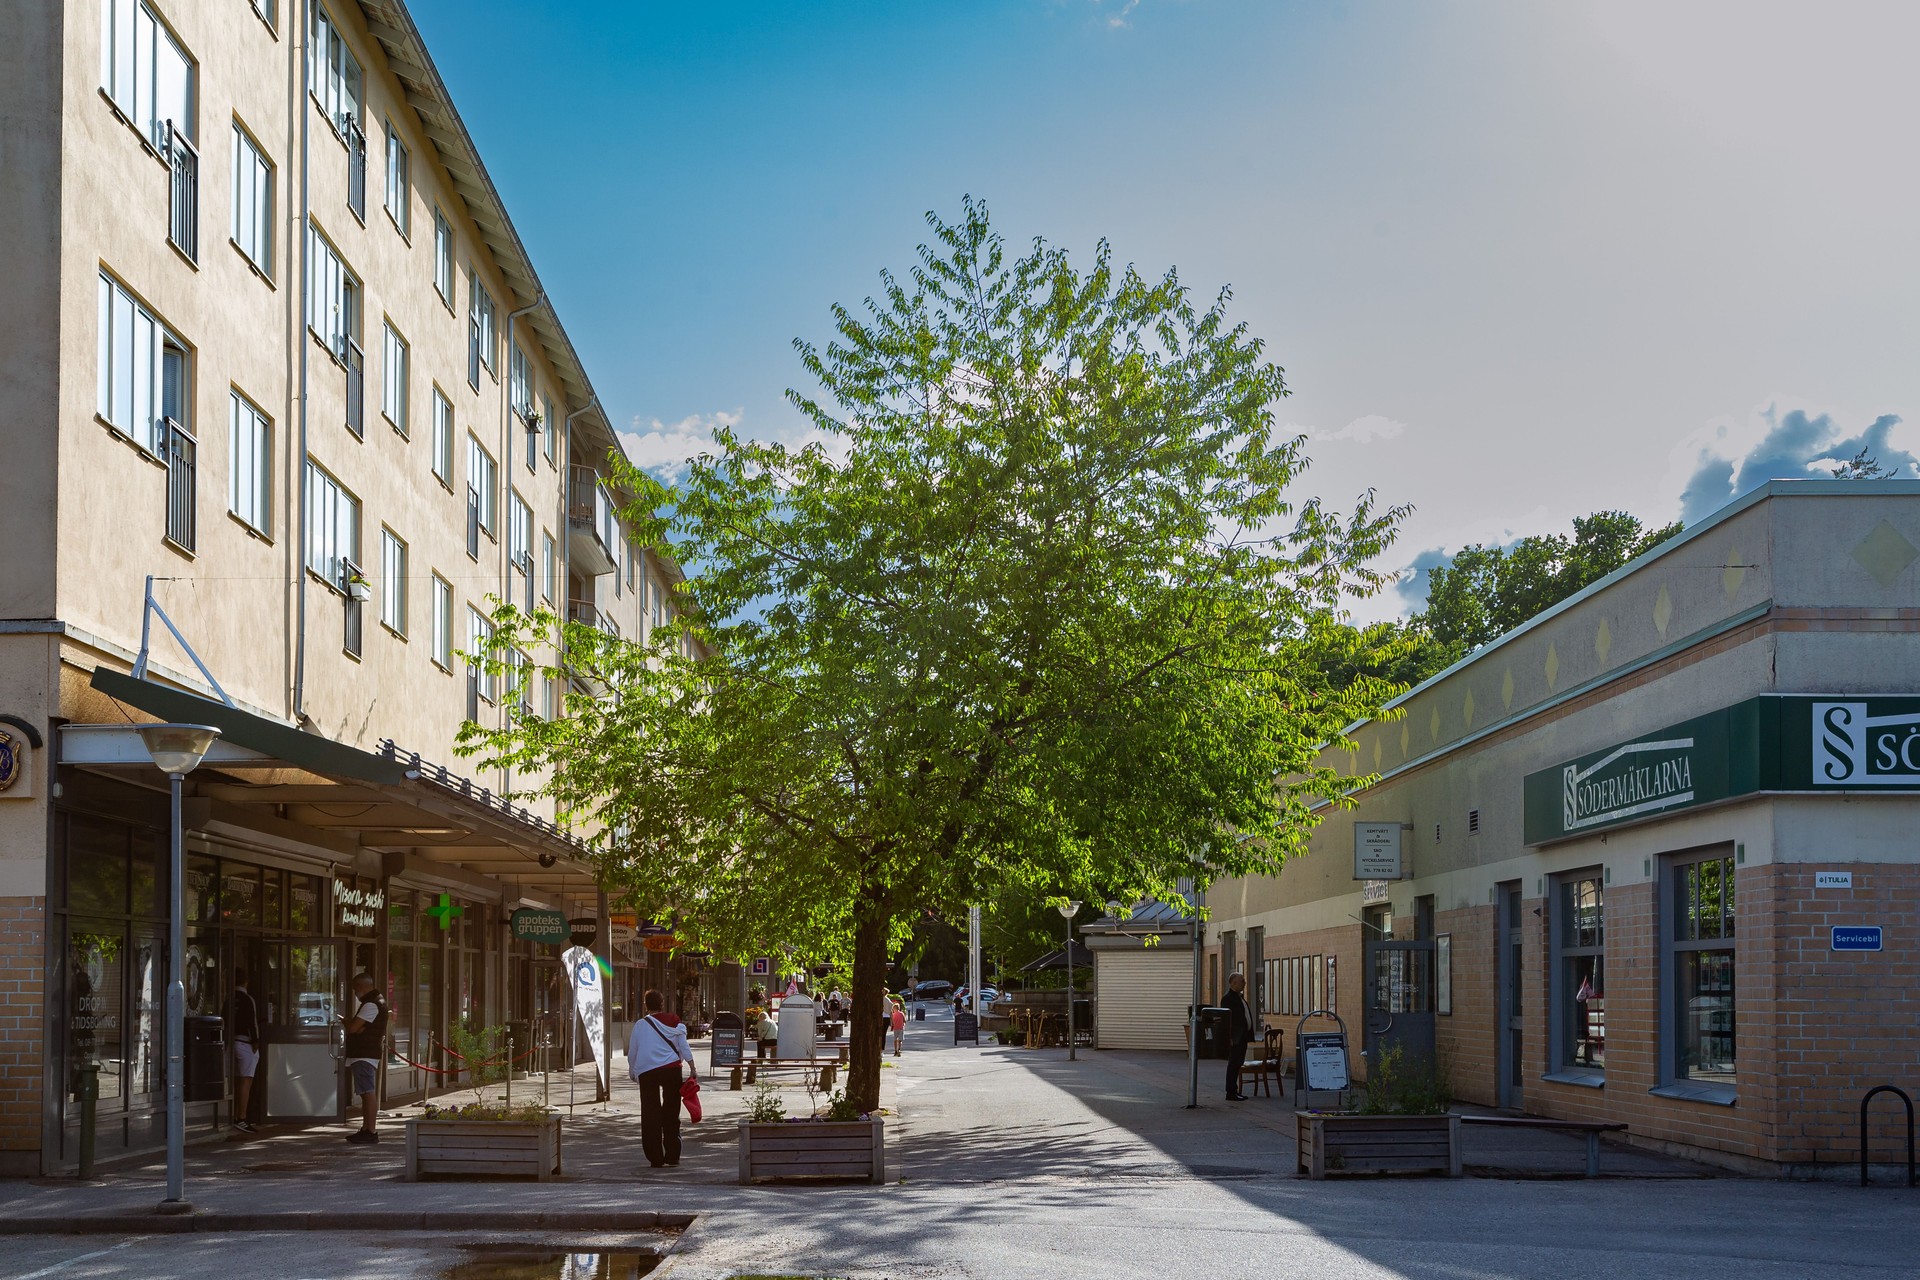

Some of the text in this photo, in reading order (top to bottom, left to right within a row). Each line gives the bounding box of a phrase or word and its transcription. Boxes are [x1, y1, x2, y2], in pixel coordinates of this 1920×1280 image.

[1578, 755, 1693, 817] SÖDERMÄKLARNA
[334, 879, 385, 909] Misora sushi
[1364, 884, 1388, 900] SERVICE
[518, 915, 560, 927] apoteks
[518, 923, 563, 935] gruppen
[571, 924, 597, 933] BURD
[1836, 934, 1878, 943] Servicebil
[75, 1016, 116, 1029] TIDSBONING
